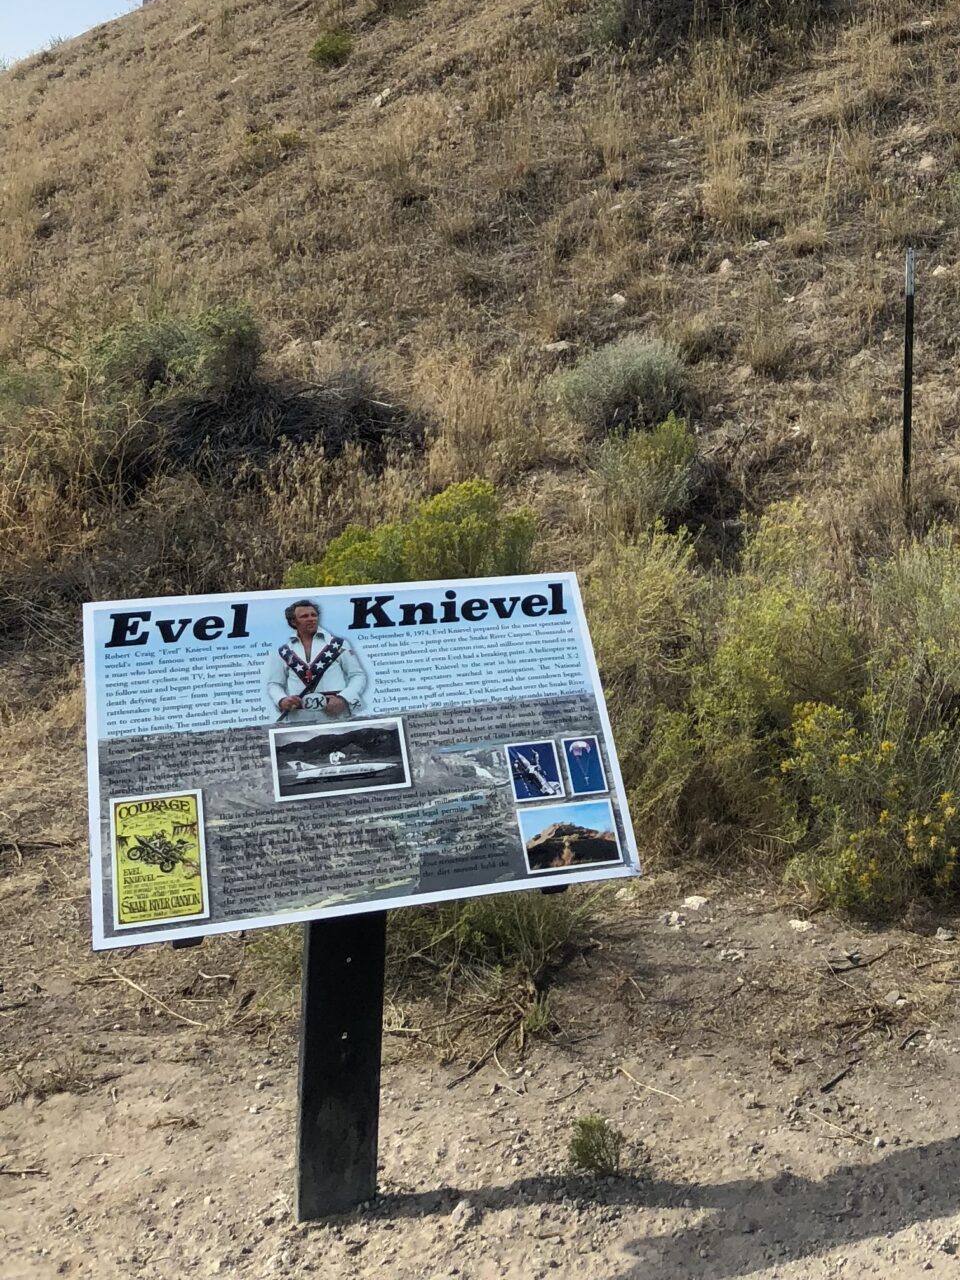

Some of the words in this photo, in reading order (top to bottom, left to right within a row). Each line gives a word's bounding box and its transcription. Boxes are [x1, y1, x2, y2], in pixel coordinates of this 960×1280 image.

[105, 603, 249, 648] Evel
[348, 583, 567, 630] Knievel
[147, 666, 167, 674] loved
[151, 676, 177, 684] cyclists
[233, 668, 260, 677] inspired
[192, 682, 232, 690] performing
[305, 696, 324, 709] EK
[106, 707, 149, 715] rattlesnakes
[162, 704, 192, 712] jumping
[185, 709, 217, 717] daredevil
[237, 714, 257, 722] loved
[119, 800, 190, 819] COURAGE
[123, 868, 141, 876] EVEL
[123, 875, 154, 884] KNIEVEL
